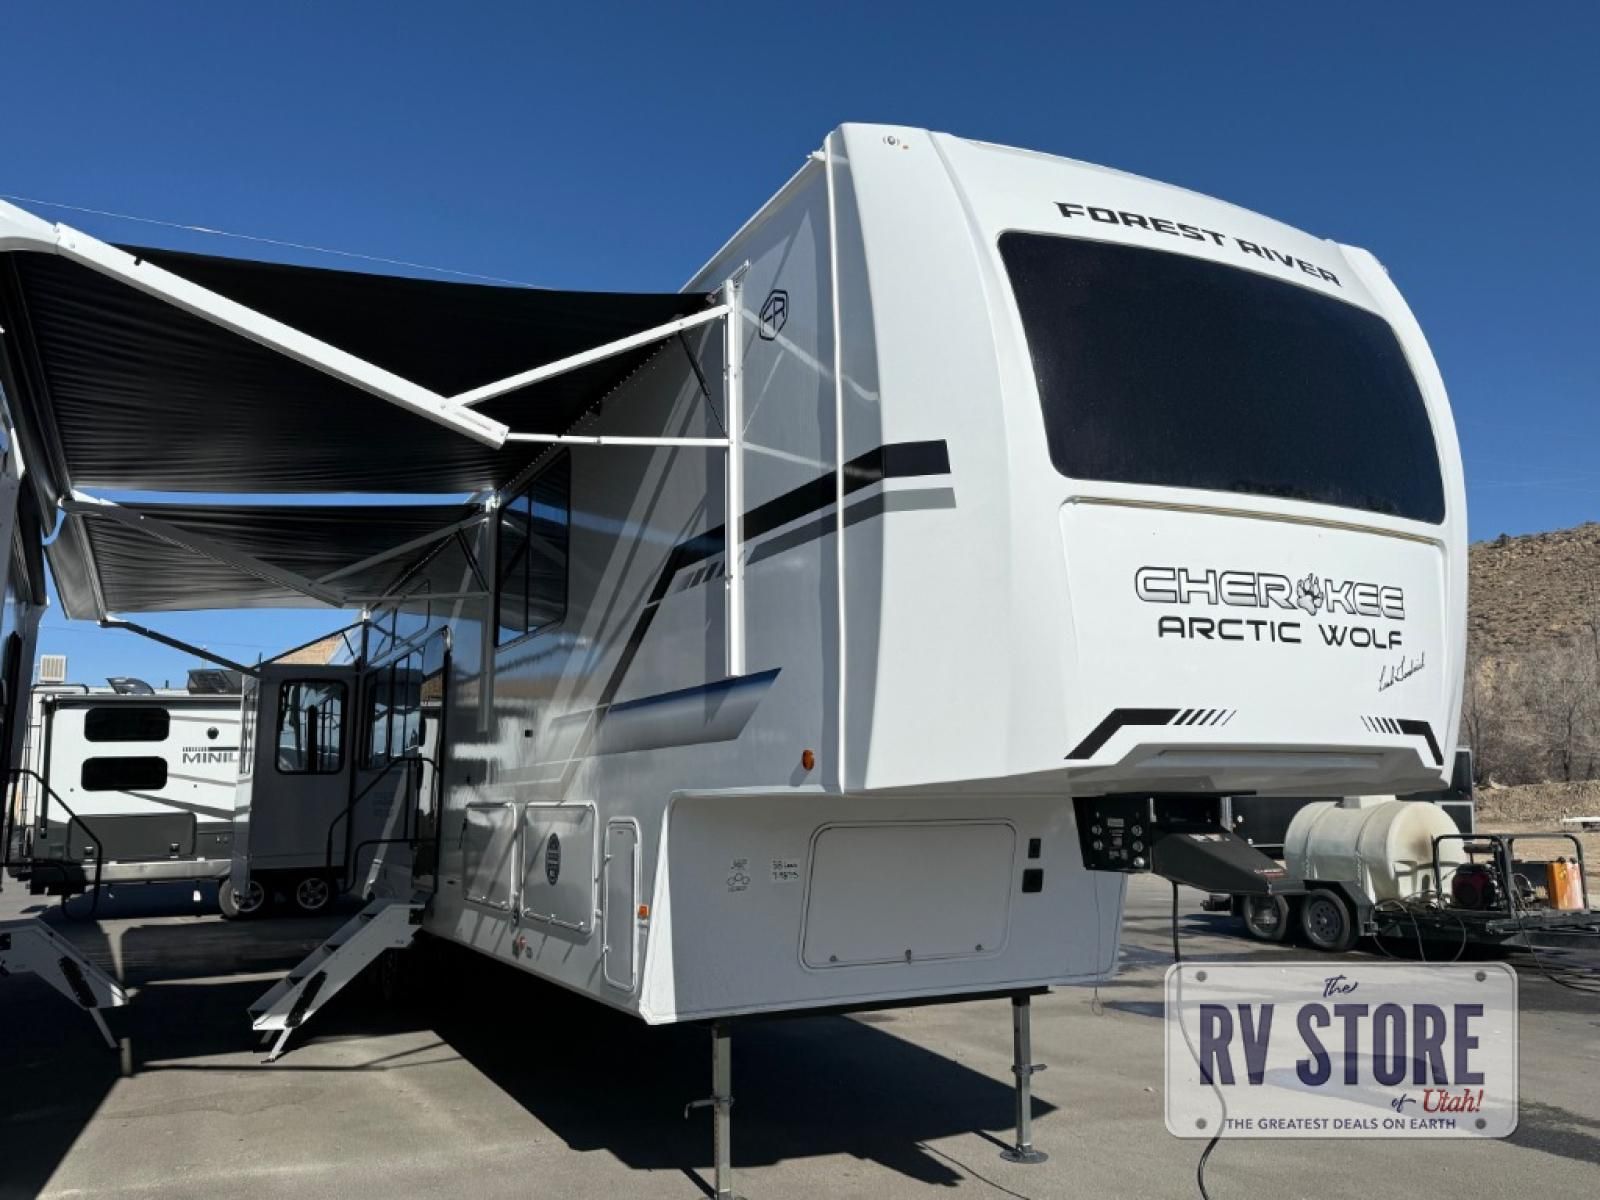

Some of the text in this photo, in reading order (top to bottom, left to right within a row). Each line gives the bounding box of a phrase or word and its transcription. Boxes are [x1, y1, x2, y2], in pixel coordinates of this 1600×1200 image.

[1056, 201, 1342, 288] FOREST RIVER
[1157, 615, 1402, 650] ARCTIC WOLF
[182, 752, 239, 764] MINIL
